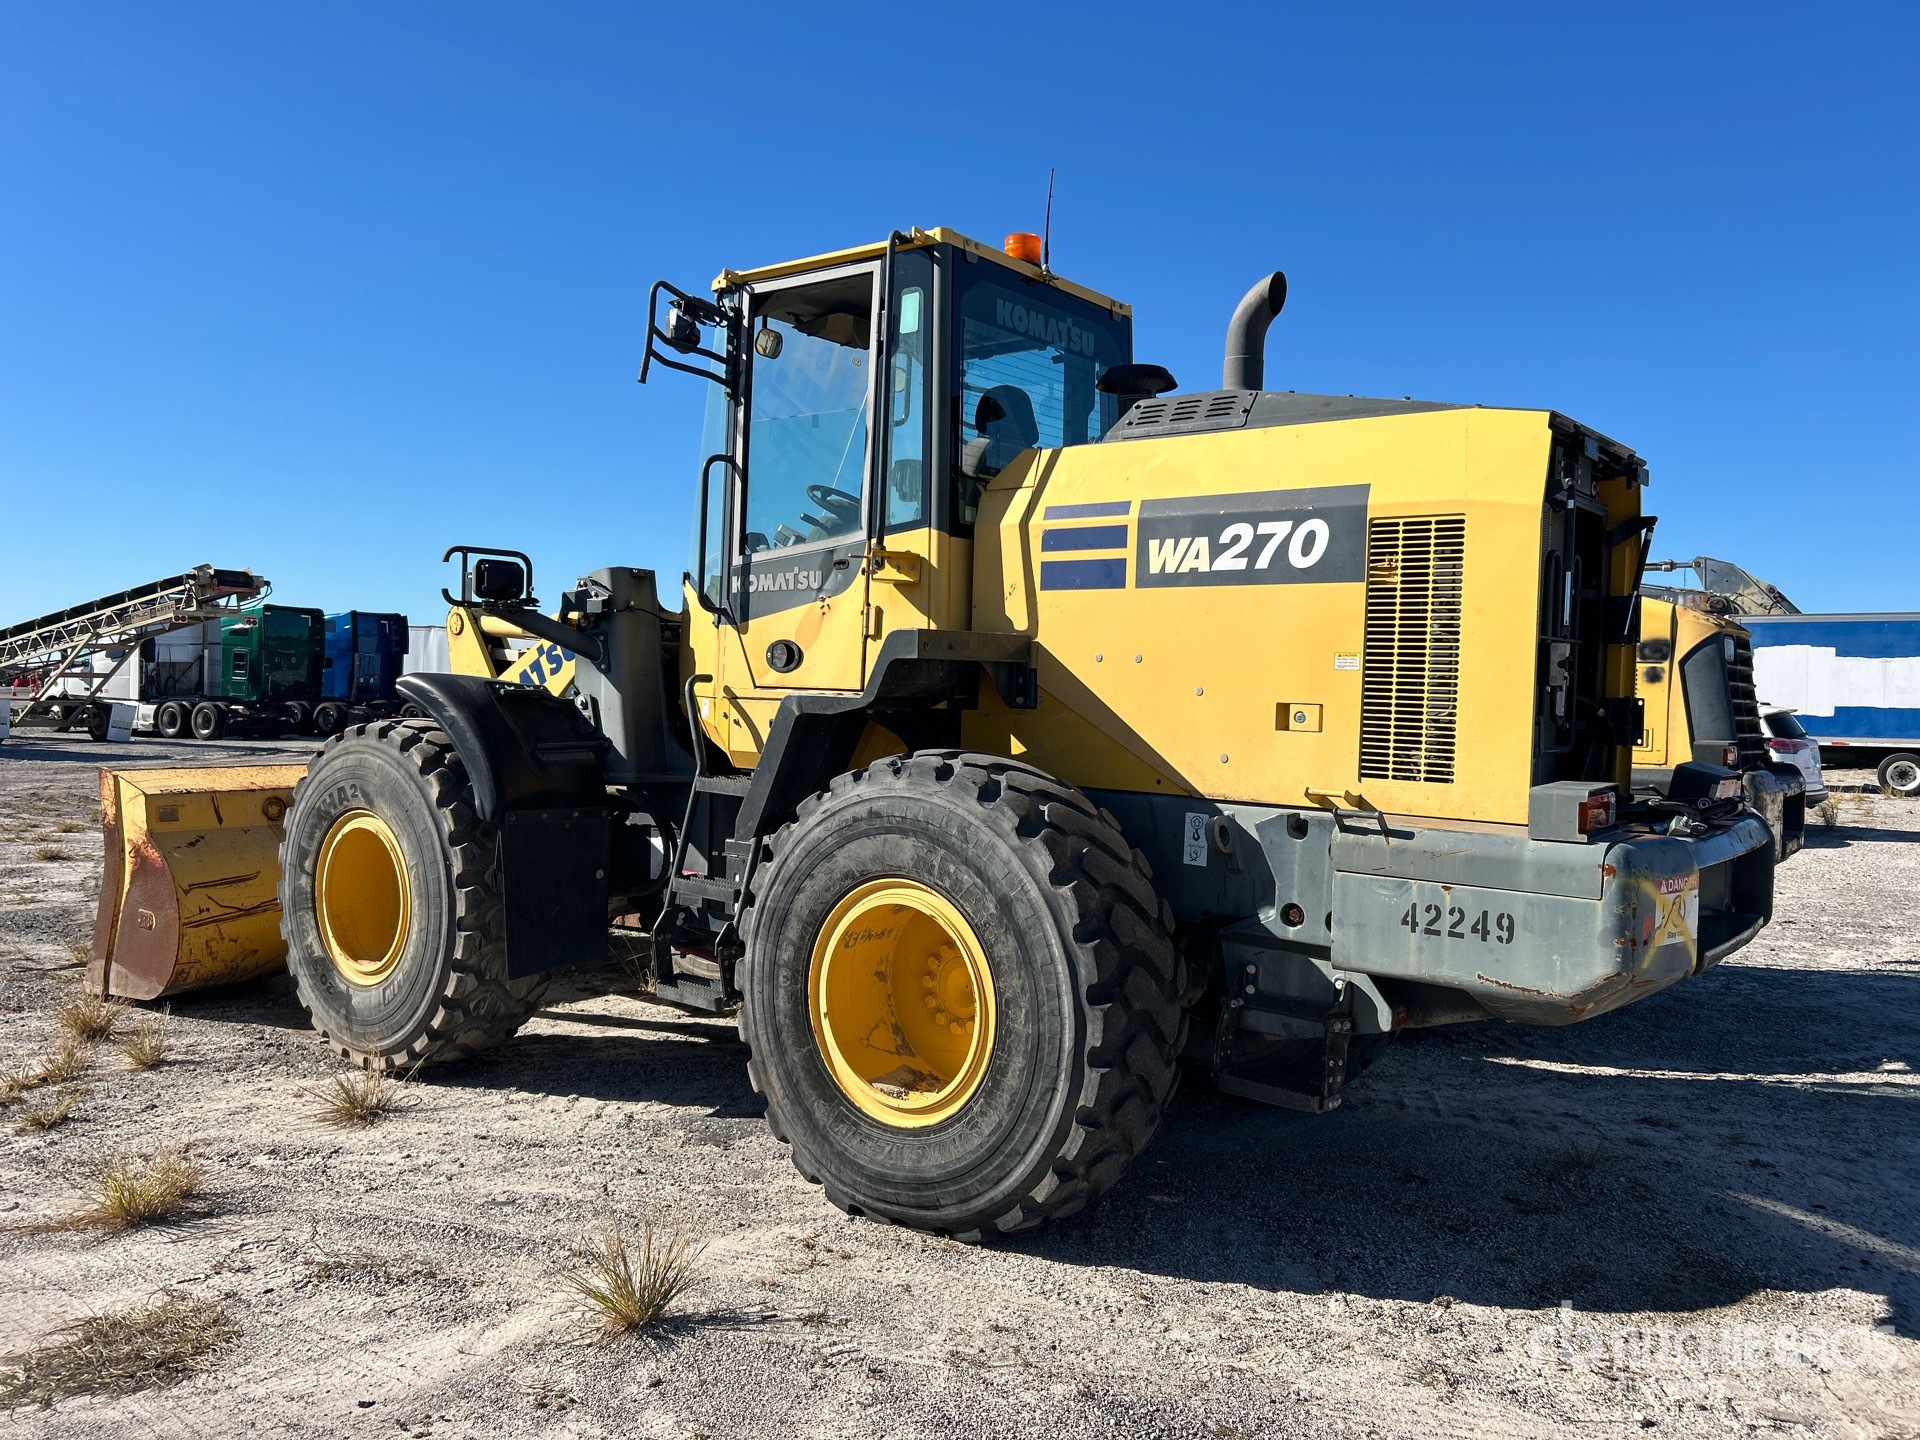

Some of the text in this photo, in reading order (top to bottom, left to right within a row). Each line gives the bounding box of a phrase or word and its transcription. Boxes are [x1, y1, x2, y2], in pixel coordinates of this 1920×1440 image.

[996, 298, 1095, 357] KOMATSU
[1149, 518, 1330, 574] WA270
[731, 566, 823, 593] KOMATSU
[1400, 902, 1515, 945] 42249
